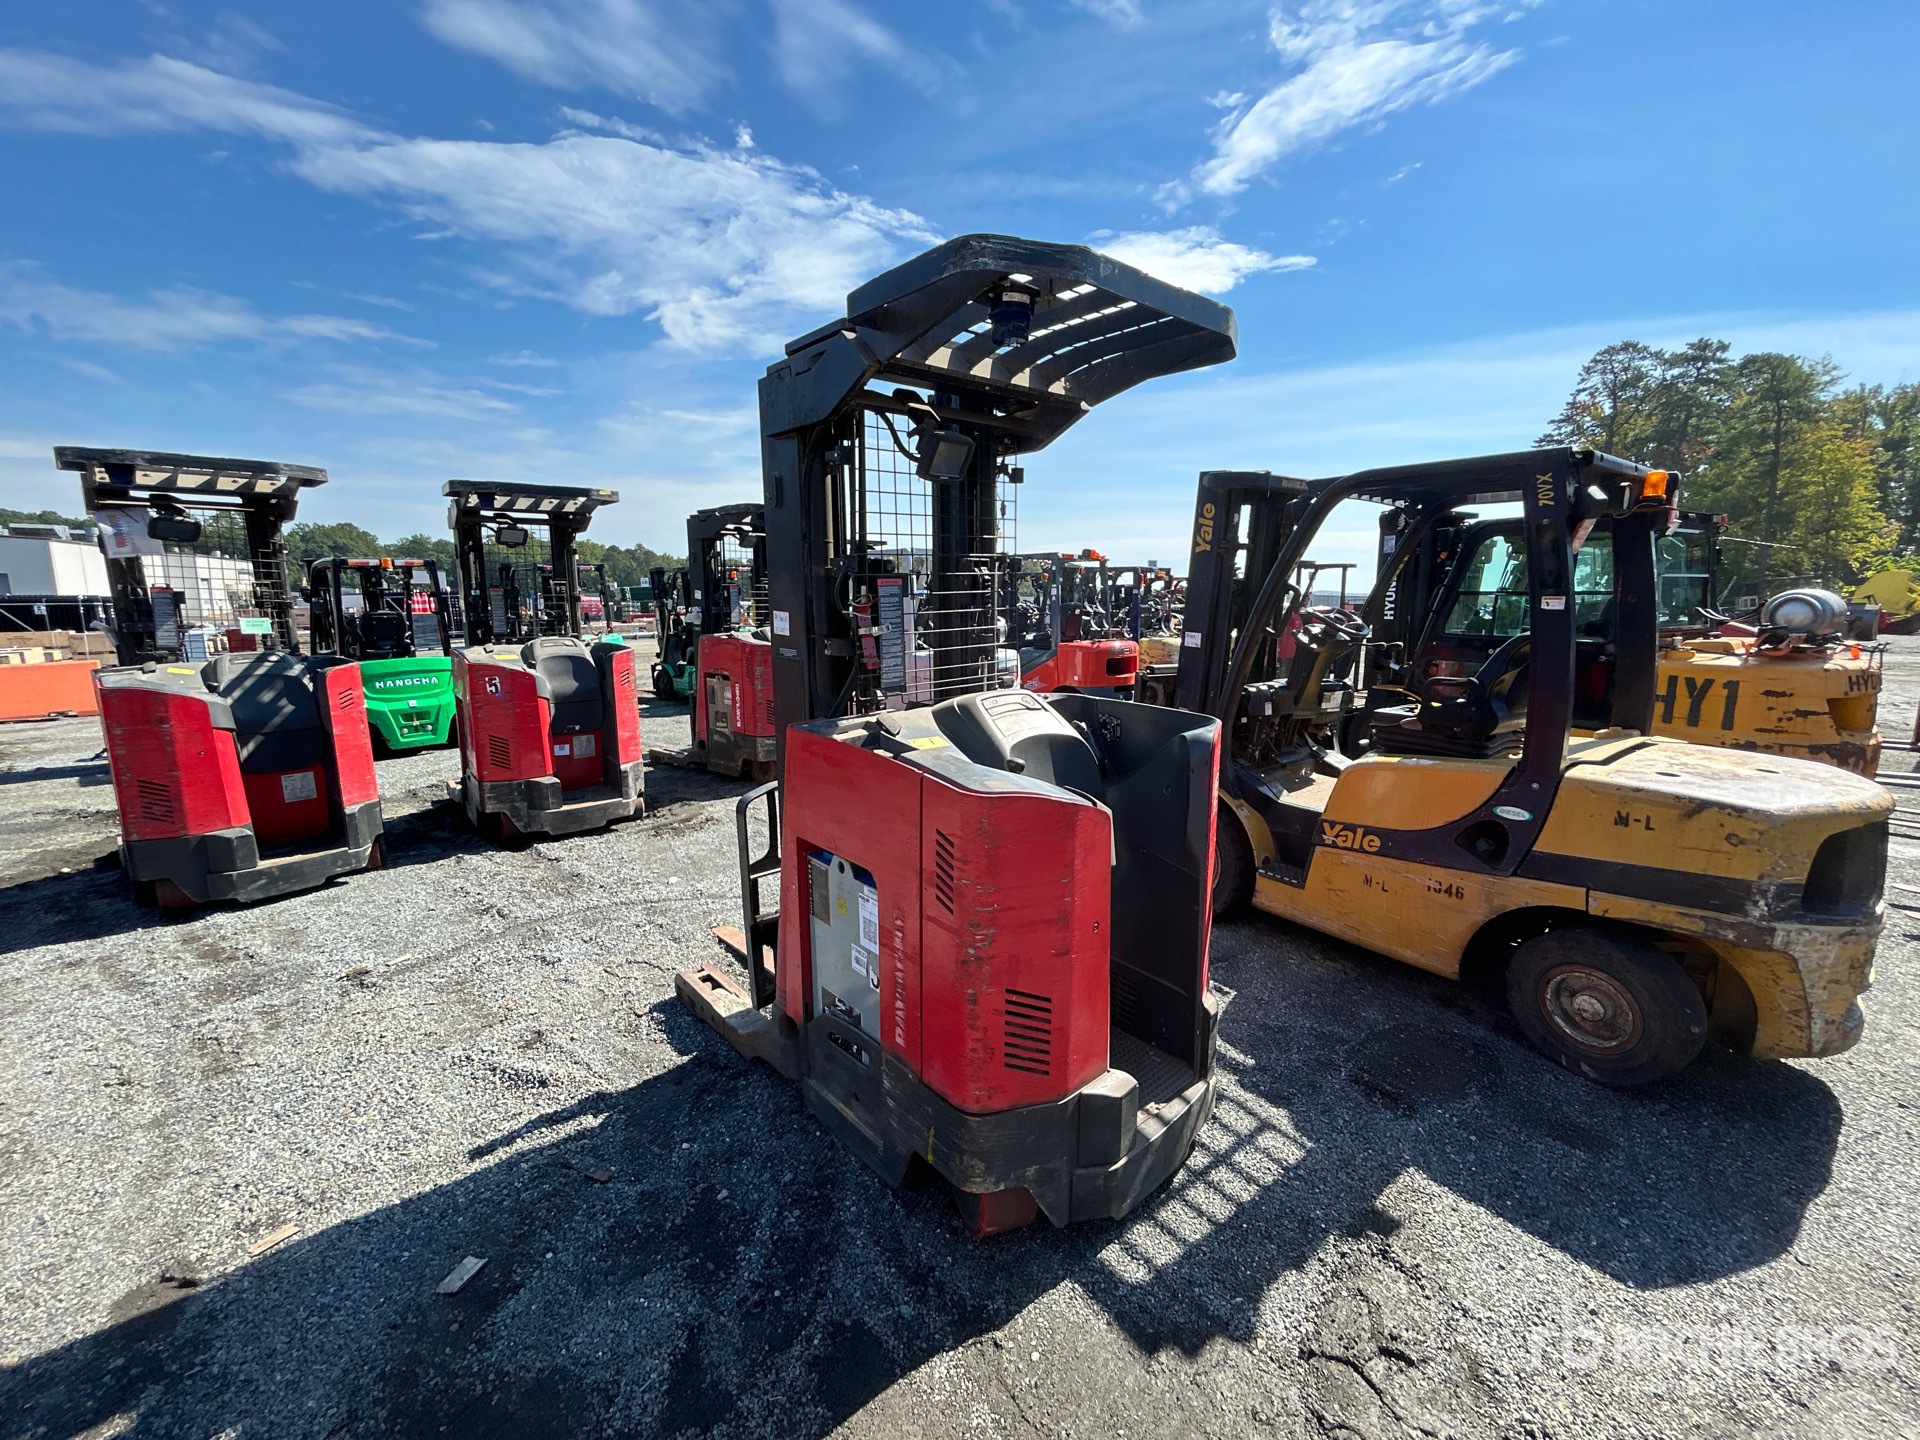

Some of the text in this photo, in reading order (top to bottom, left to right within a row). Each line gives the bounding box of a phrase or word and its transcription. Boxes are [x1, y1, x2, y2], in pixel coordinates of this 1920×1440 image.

[1536, 472, 1555, 506] 70VX
[1195, 502, 1215, 553] Yale
[375, 676, 439, 689] HANGCHA
[1499, 807, 1528, 819] DIESEL
[1321, 822, 1382, 852] Yale
